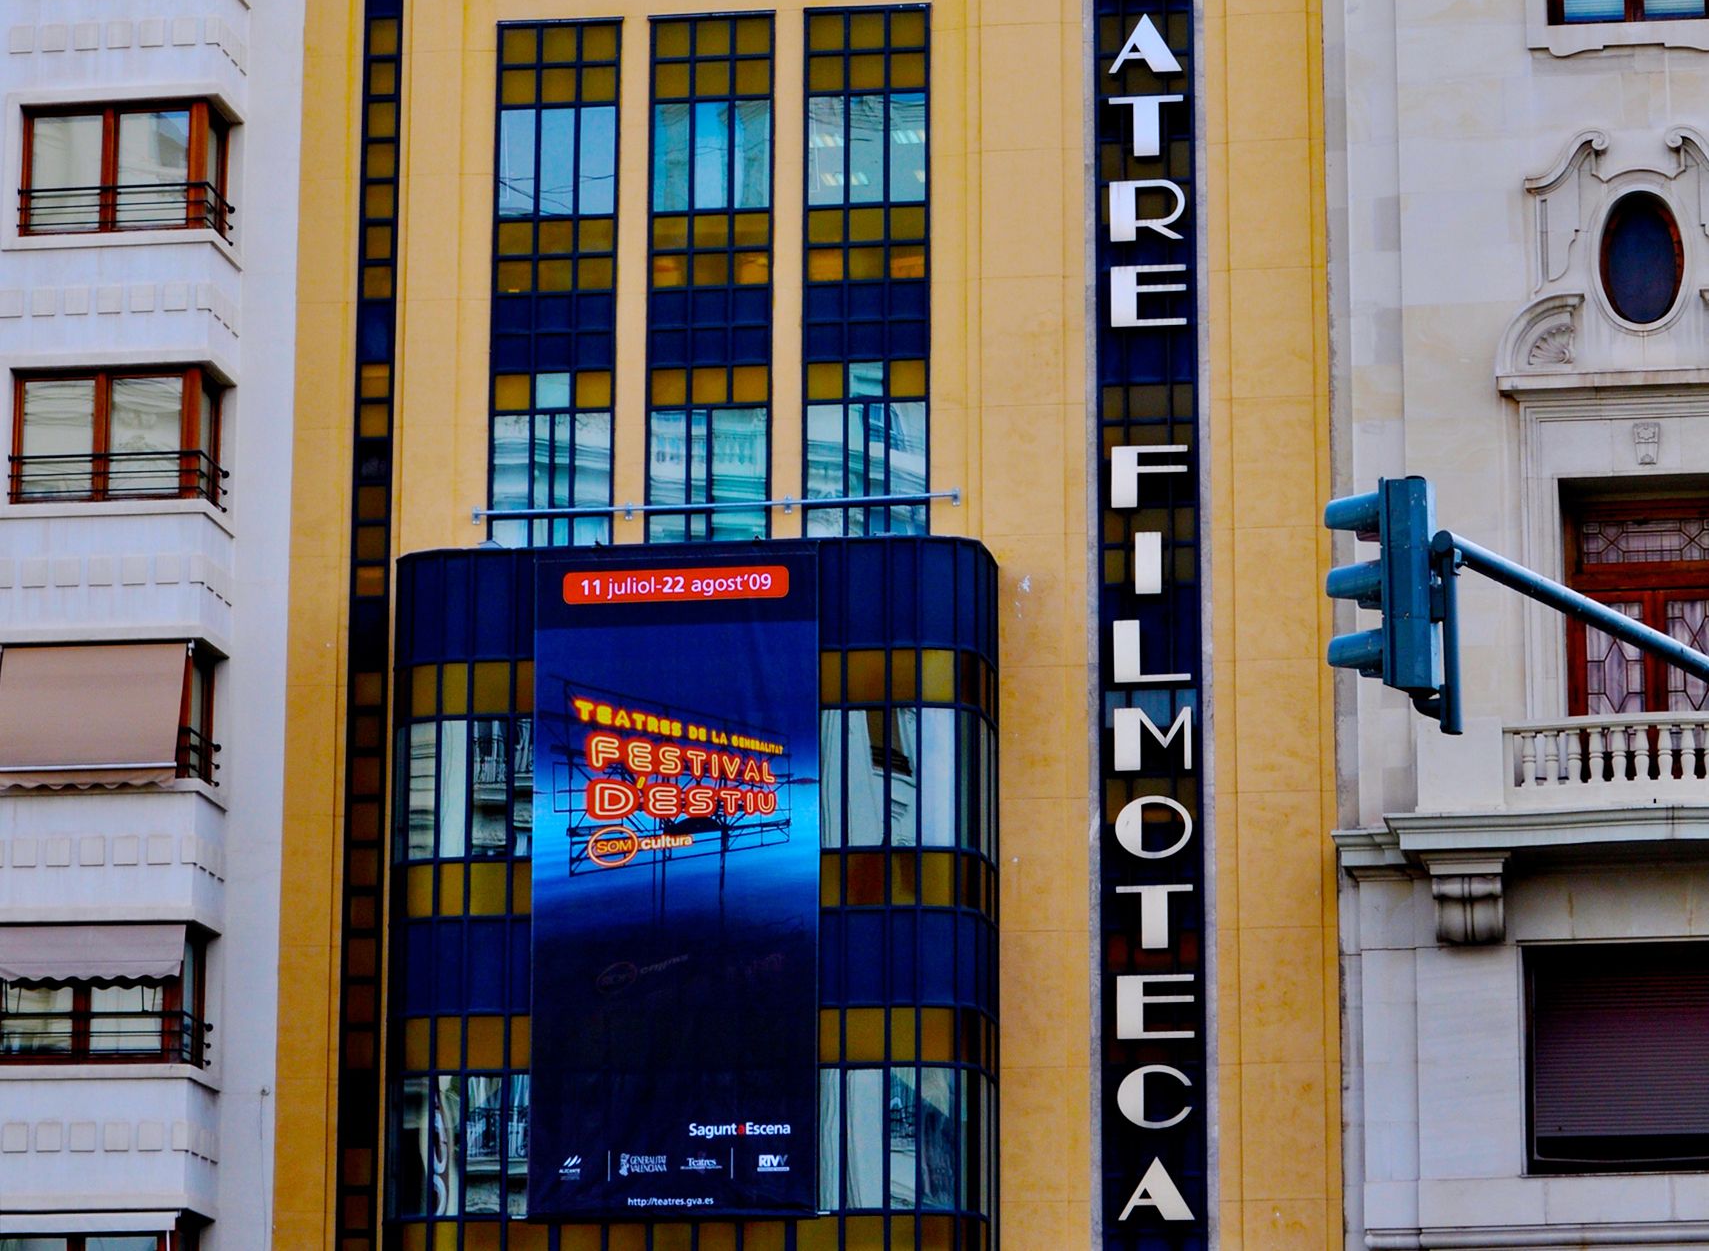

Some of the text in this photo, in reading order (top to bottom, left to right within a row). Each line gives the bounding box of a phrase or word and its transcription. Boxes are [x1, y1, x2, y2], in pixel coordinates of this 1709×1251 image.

[581, 579, 601, 596] 11
[574, 699, 784, 755] TEATRES DE LA GENERALITAT
[589, 735, 777, 784] FESTIVAL
[593, 776, 778, 816] D'ESTIU
[596, 834, 693, 854] SOM cultura
[1110, 444, 1196, 1222] FILMOTECA
[687, 1157, 718, 1167] Teatres
[627, 1196, 714, 1208] http://teatres.gva.es
